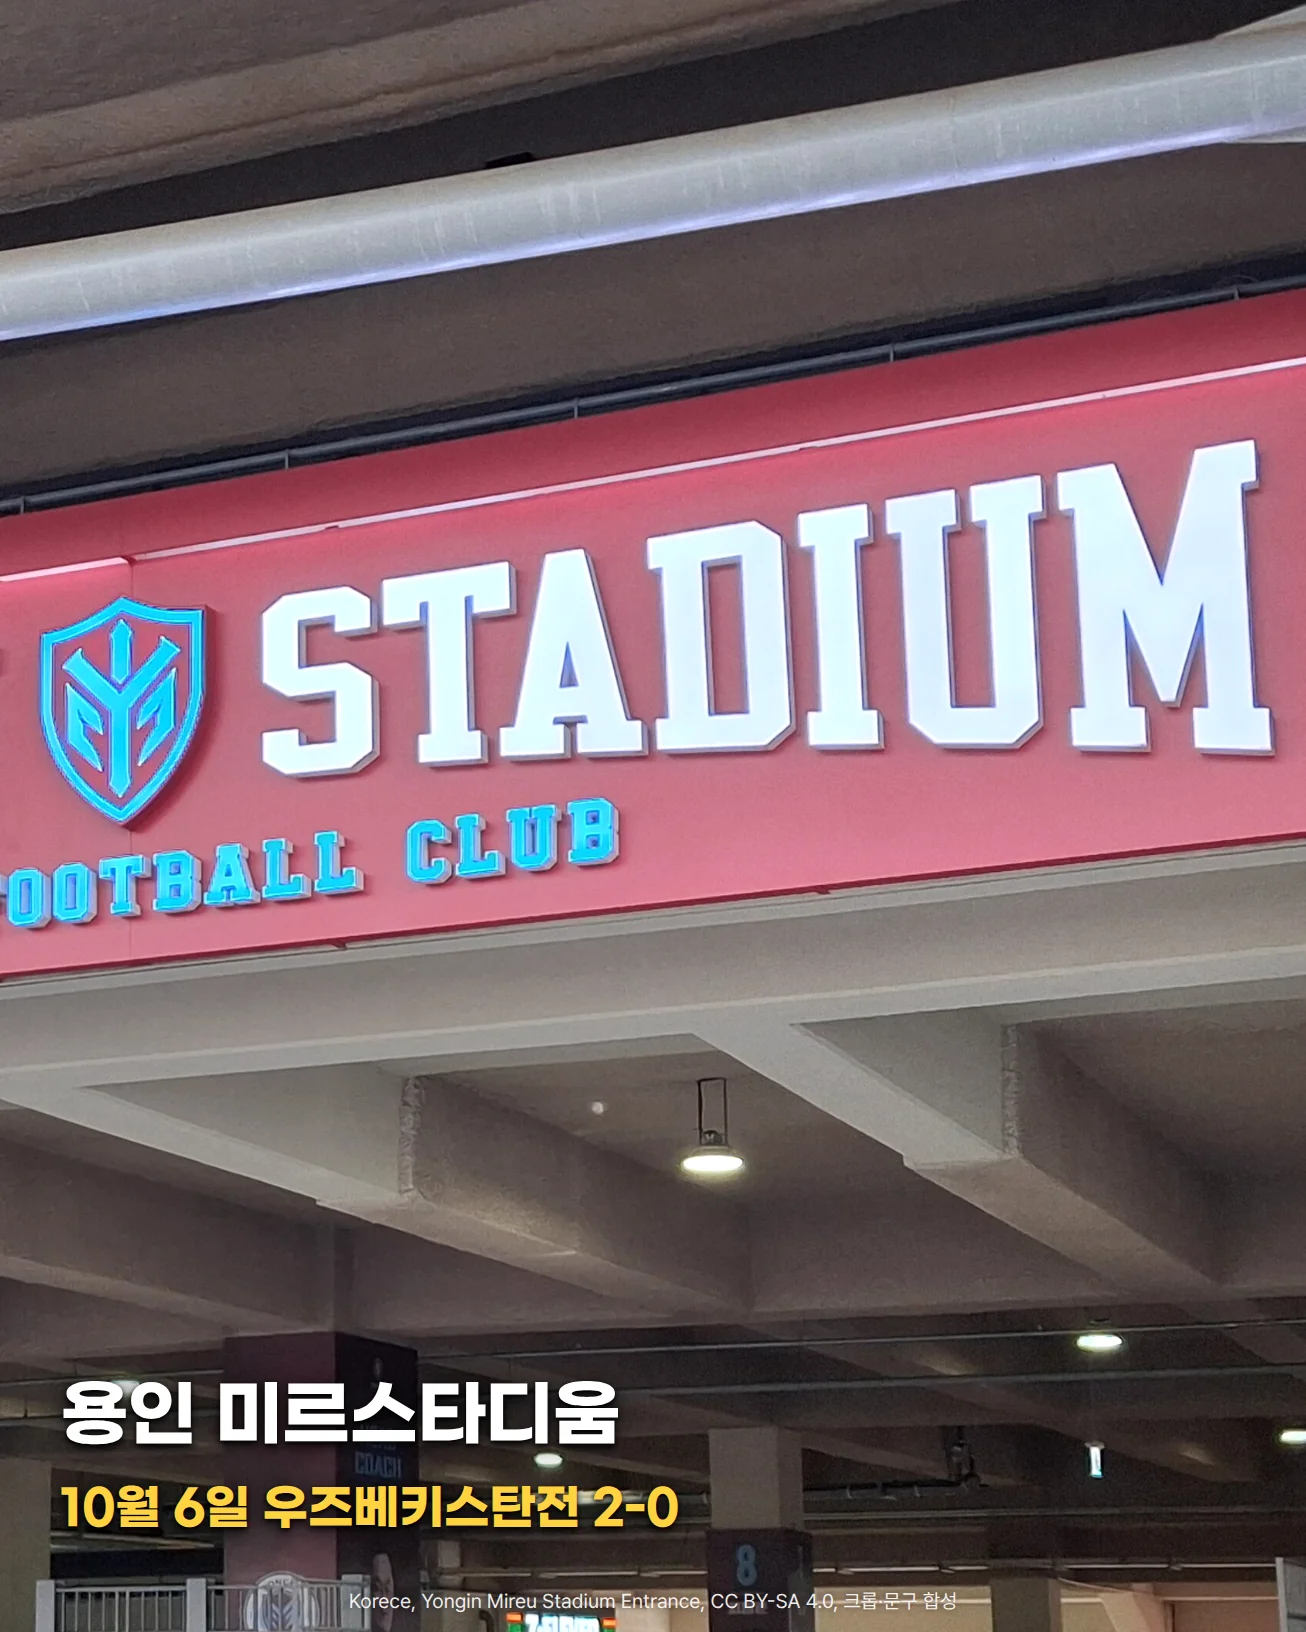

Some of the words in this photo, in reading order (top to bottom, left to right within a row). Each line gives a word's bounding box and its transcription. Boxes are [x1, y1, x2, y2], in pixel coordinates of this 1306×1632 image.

[260, 439, 1275, 778] STADIUM
[0, 829, 364, 929] OOTBALL
[405, 797, 620, 885] CLUB
[736, 1544, 758, 1587] 8
